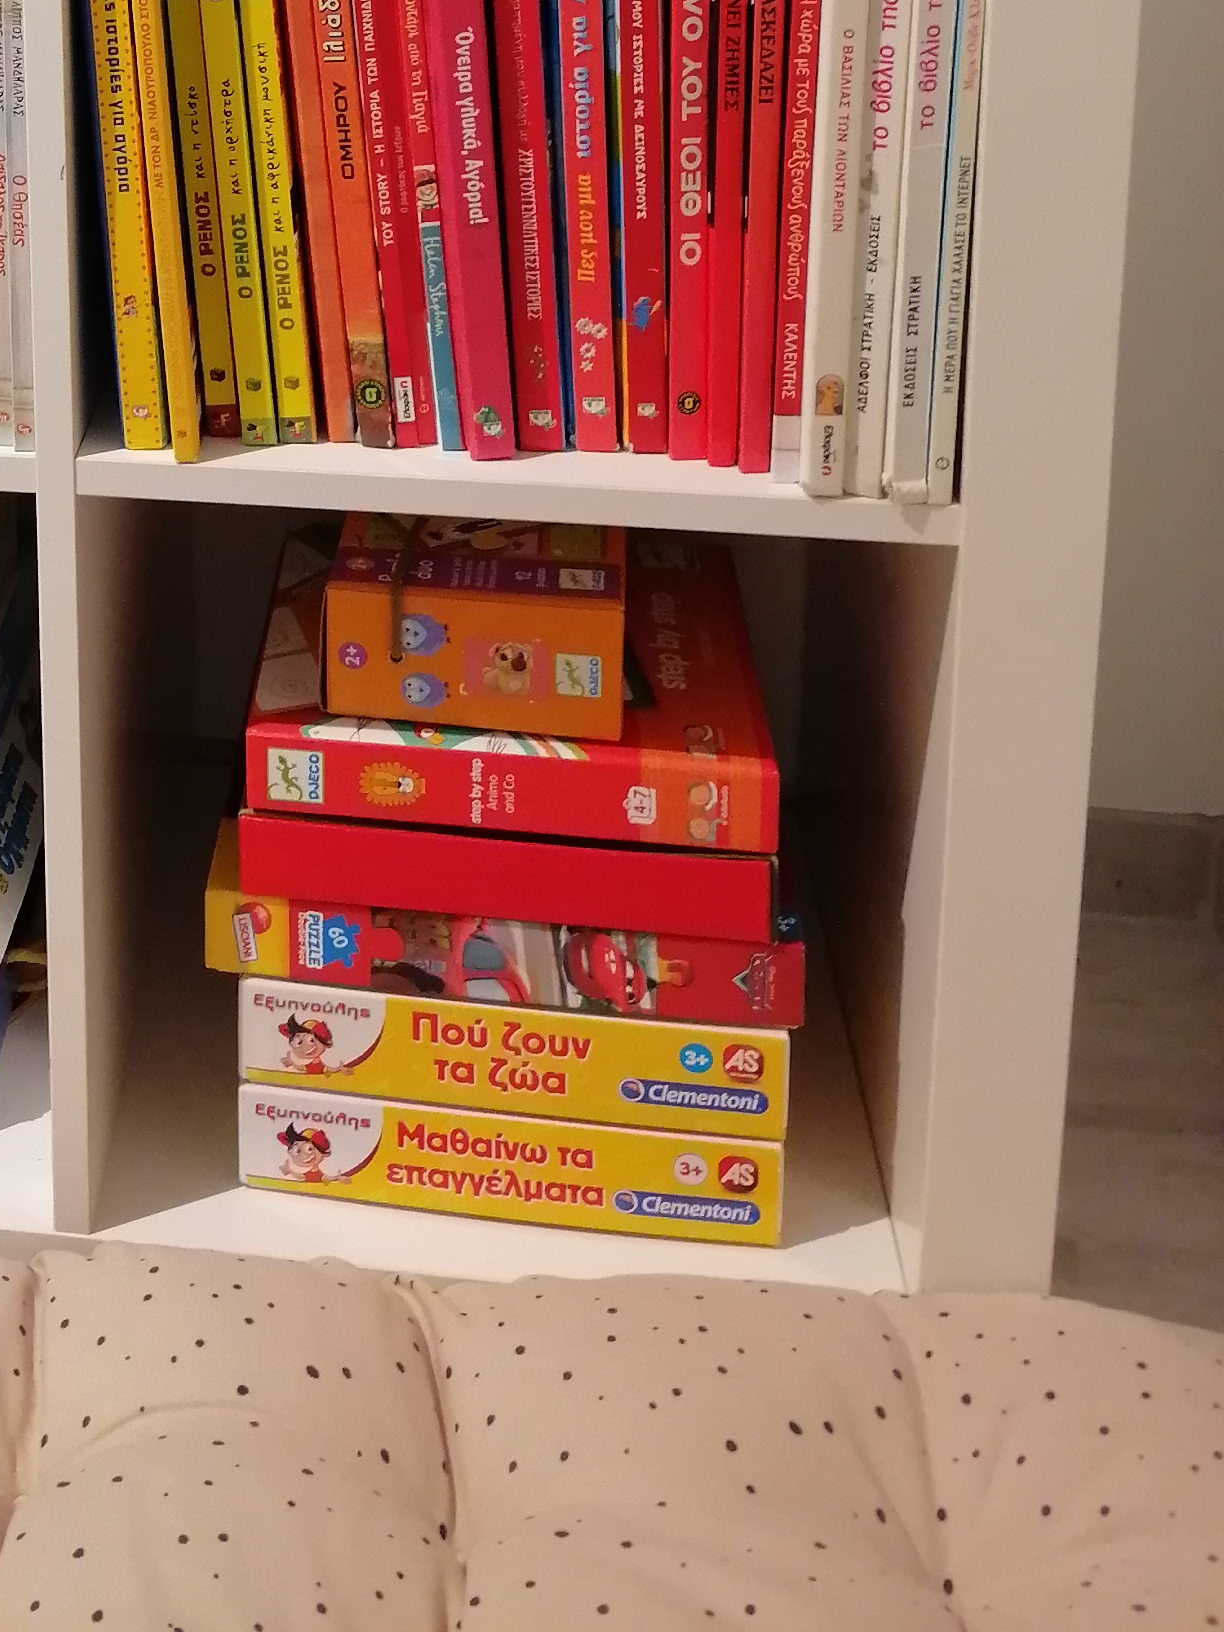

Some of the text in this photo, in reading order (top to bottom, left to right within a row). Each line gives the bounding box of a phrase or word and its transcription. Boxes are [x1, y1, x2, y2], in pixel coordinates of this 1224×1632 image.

[632, 0, 642, 27] ΜΟΥ
[572, 16, 593, 56] για
[844, 29, 854, 39] Ο
[365, 58, 378, 84] ΤΩΝ
[633, 35, 644, 94] ΙΣΤΟΡΙΕΣ
[793, 59, 810, 76] με
[839, 46, 853, 108] ΒΑΣΙΛΙΑΣ
[918, 25, 940, 92] βιβλίο
[681, 56, 702, 121] ΤΟΥ
[792, 80, 813, 113] τους
[870, 46, 894, 113] βιβλίο
[333, 80, 354, 180] ΟΜΗΡΟΥ
[370, 89, 384, 138] ΙΣΤΟΡΙΑ
[569, 67, 594, 159] ιστορία
[837, 114, 849, 142] ΤΩΝ
[920, 106, 935, 129] το
[374, 144, 385, 152] Η
[872, 127, 888, 151] το
[230, 172, 241, 195] και
[577, 174, 595, 205] μια
[634, 125, 647, 219] ΔΕΙΝΟΣΑΥΡΟΥΣ
[679, 137, 702, 216] ΘΕΟΙ
[831, 148, 847, 233] ΛΙΟΝΤΑΡΙΩΝ
[377, 173, 392, 215] STORY
[232, 213, 250, 278] ΡΕΝΟΣ
[578, 210, 597, 244] μου
[866, 214, 880, 272] ΕΚΔΟΣΕΙΣ
[577, 249, 596, 282] Πες
[679, 233, 702, 265] ΟΙ
[239, 287, 253, 298] Ο
[906, 275, 922, 336] ΣΤΡΑΤΙΚΗ
[862, 292, 875, 352] ΣΤΡΑΤΙΚΗ
[781, 323, 798, 400] ΚΑΛΕΝΤΗΣ
[902, 347, 917, 408] ΕΚΔΟΣΕΙΣ
[857, 357, 870, 413] ΑΔΕΛΦΟΙ
[344, 644, 361, 667] 2+
[307, 753, 321, 801] DJECO
[469, 785, 483, 797] by
[634, 789, 646, 814] 4-7
[307, 913, 321, 968] PUZZLE
[327, 926, 349, 949] 60
[411, 1011, 591, 1060] Πού ζουν
[433, 1056, 567, 1096] τα ζώα
[684, 1048, 710, 1069] 3+
[724, 1047, 760, 1075] AS
[648, 1083, 760, 1112] Clementoni
[396, 1121, 595, 1170] Μαθαίνω τα
[387, 1161, 605, 1208] επαγγέλματα
[678, 1160, 703, 1179] 3+
[721, 1158, 755, 1189] AS
[641, 1195, 752, 1224] Clementoni
